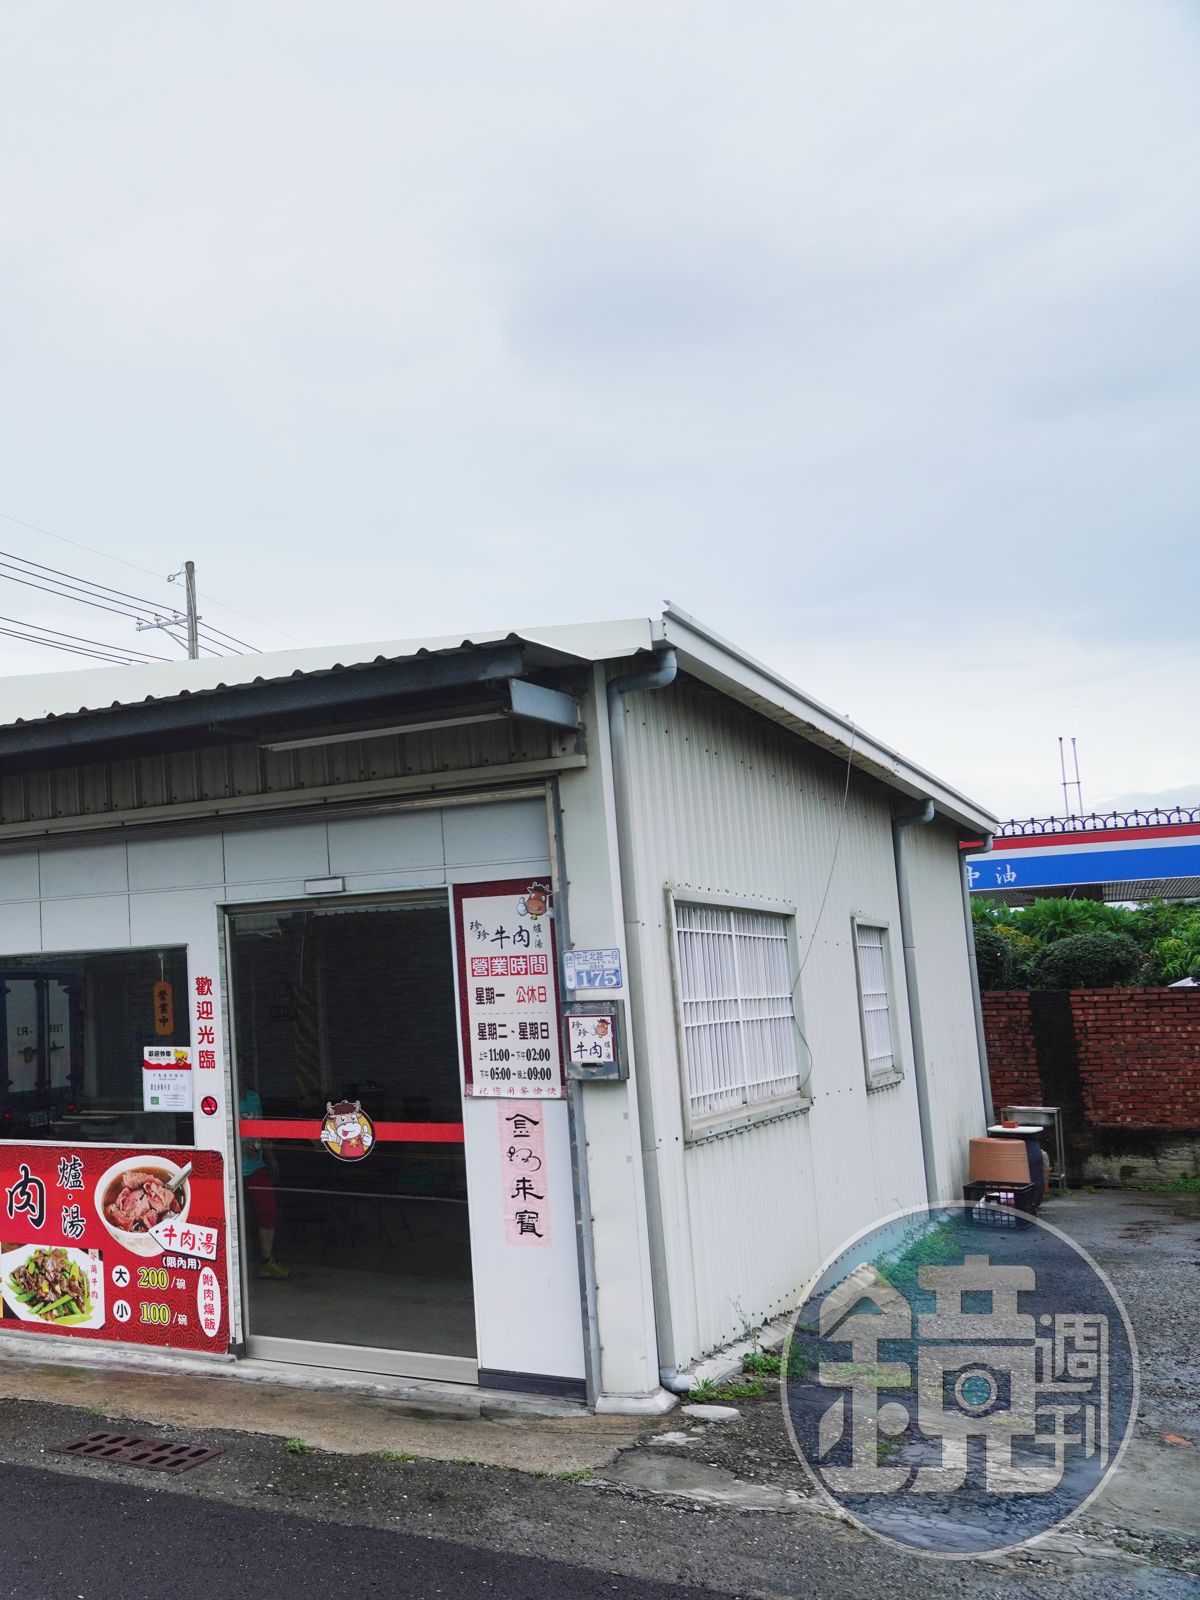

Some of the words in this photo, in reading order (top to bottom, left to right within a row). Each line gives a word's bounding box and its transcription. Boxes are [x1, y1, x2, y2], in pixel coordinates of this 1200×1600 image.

[471, 954, 548, 977] 營業時間
[580, 970, 617, 987] 175
[475, 986, 505, 1005] 星期一
[516, 986, 547, 1004] 公休日
[195, 976, 216, 1069] 歡迎光臨
[573, 1040, 603, 1059] 牛肉
[162, 1224, 216, 1255] 牛肉湯
[114, 1268, 128, 1284] 大
[137, 1267, 169, 1290] 200
[202, 1273, 216, 1331] 附肉燥飯
[116, 1303, 129, 1319] 小
[139, 1302, 171, 1326] 100
